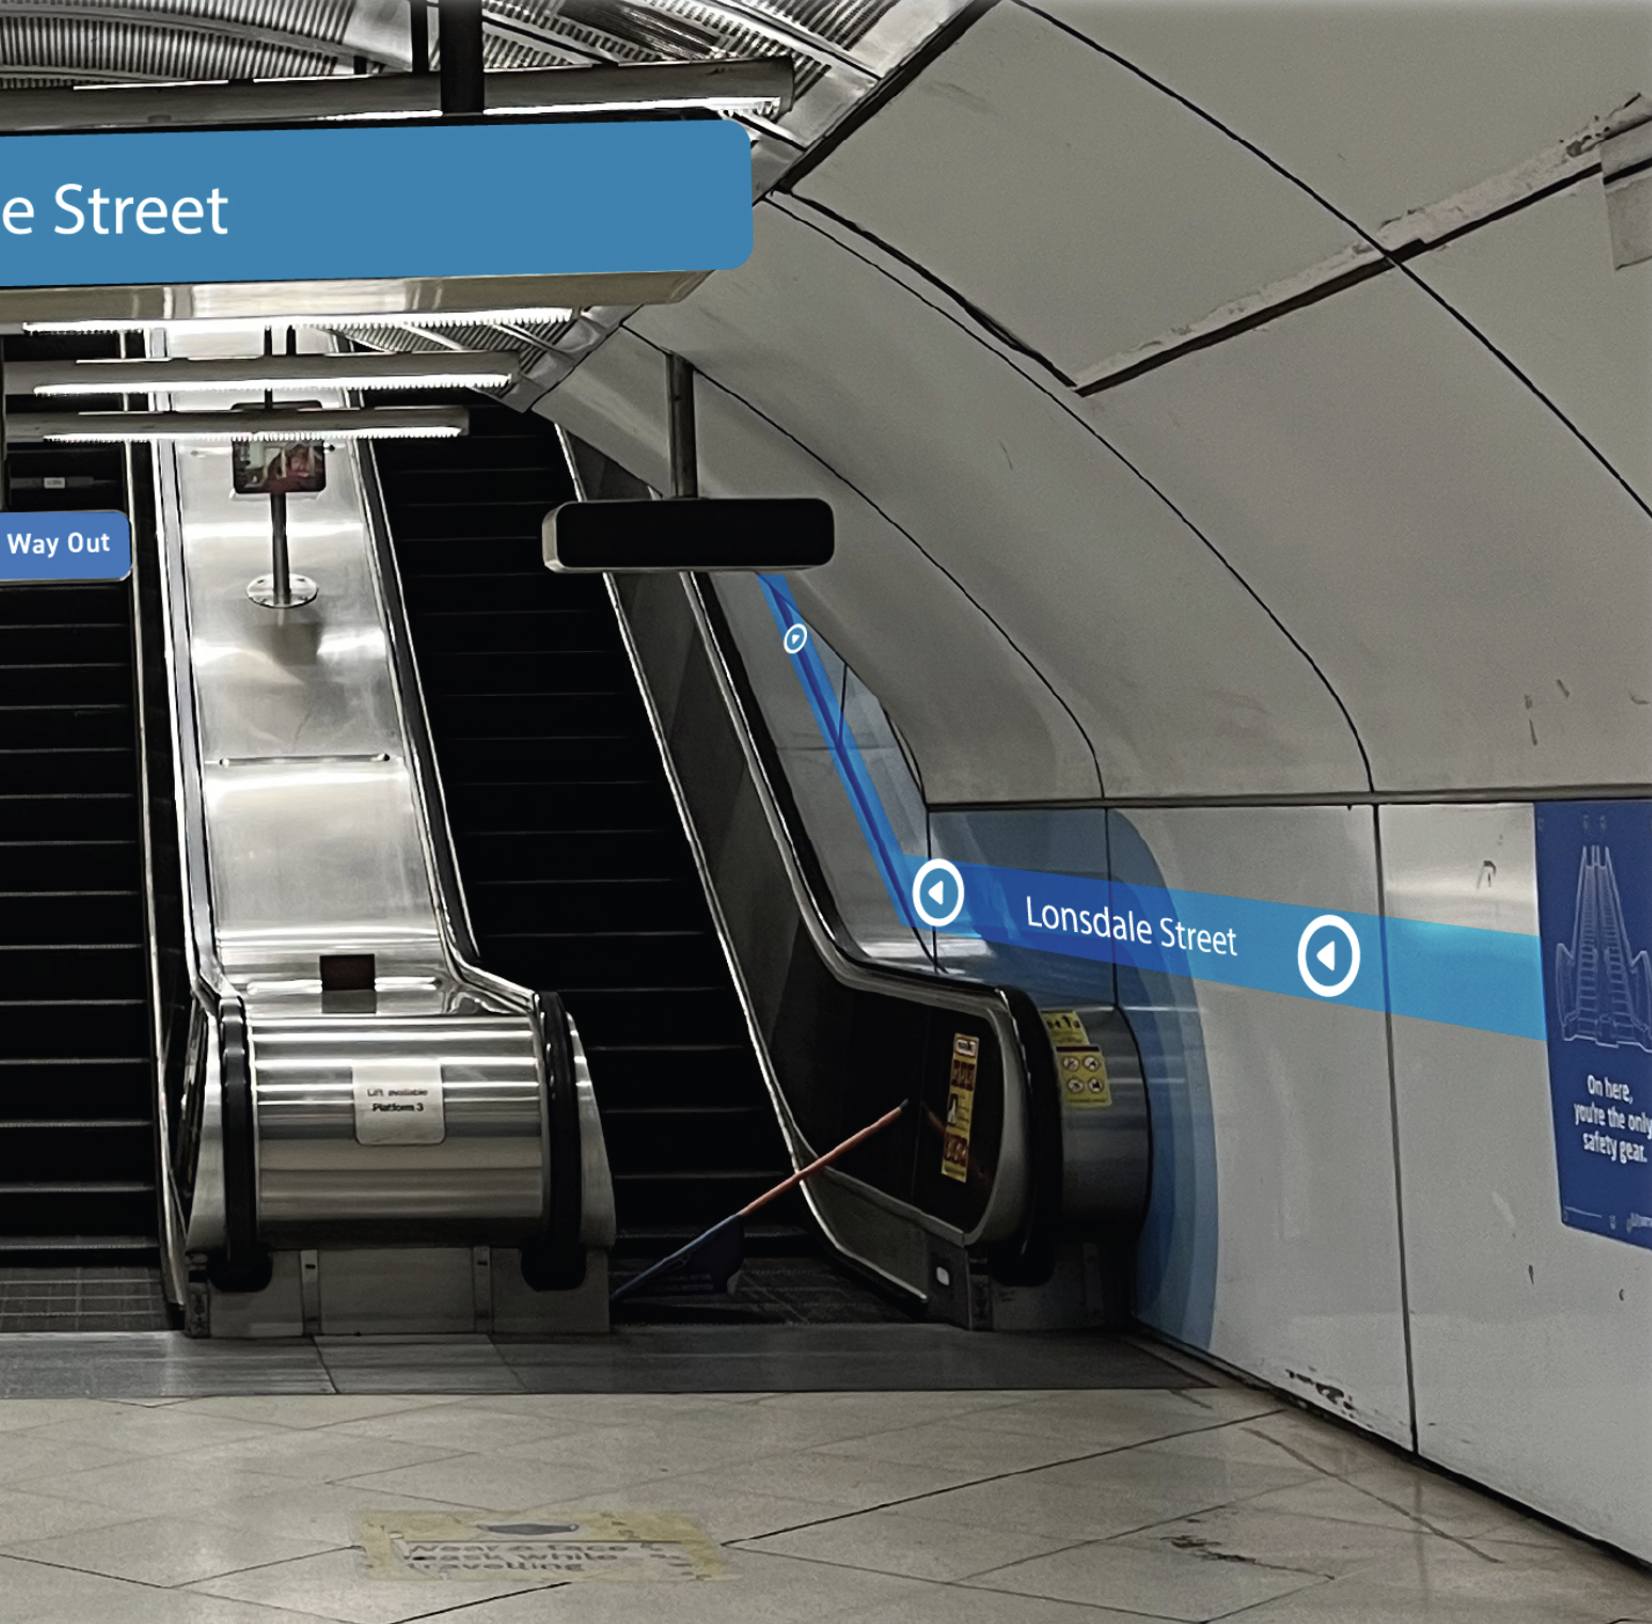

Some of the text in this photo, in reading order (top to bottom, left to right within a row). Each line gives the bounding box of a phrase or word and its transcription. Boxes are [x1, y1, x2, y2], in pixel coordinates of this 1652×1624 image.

[54, 183, 228, 235] Street
[7, 532, 110, 558] Way Out
[1026, 896, 1238, 956] Lonsdale Street
[1587, 1074, 1634, 1105] On here,
[416, 1102, 424, 1112] 3
[1607, 1105, 1626, 1130] the
[1627, 1111, 1652, 1140] only
[1583, 1130, 1648, 1164] safety gear.
